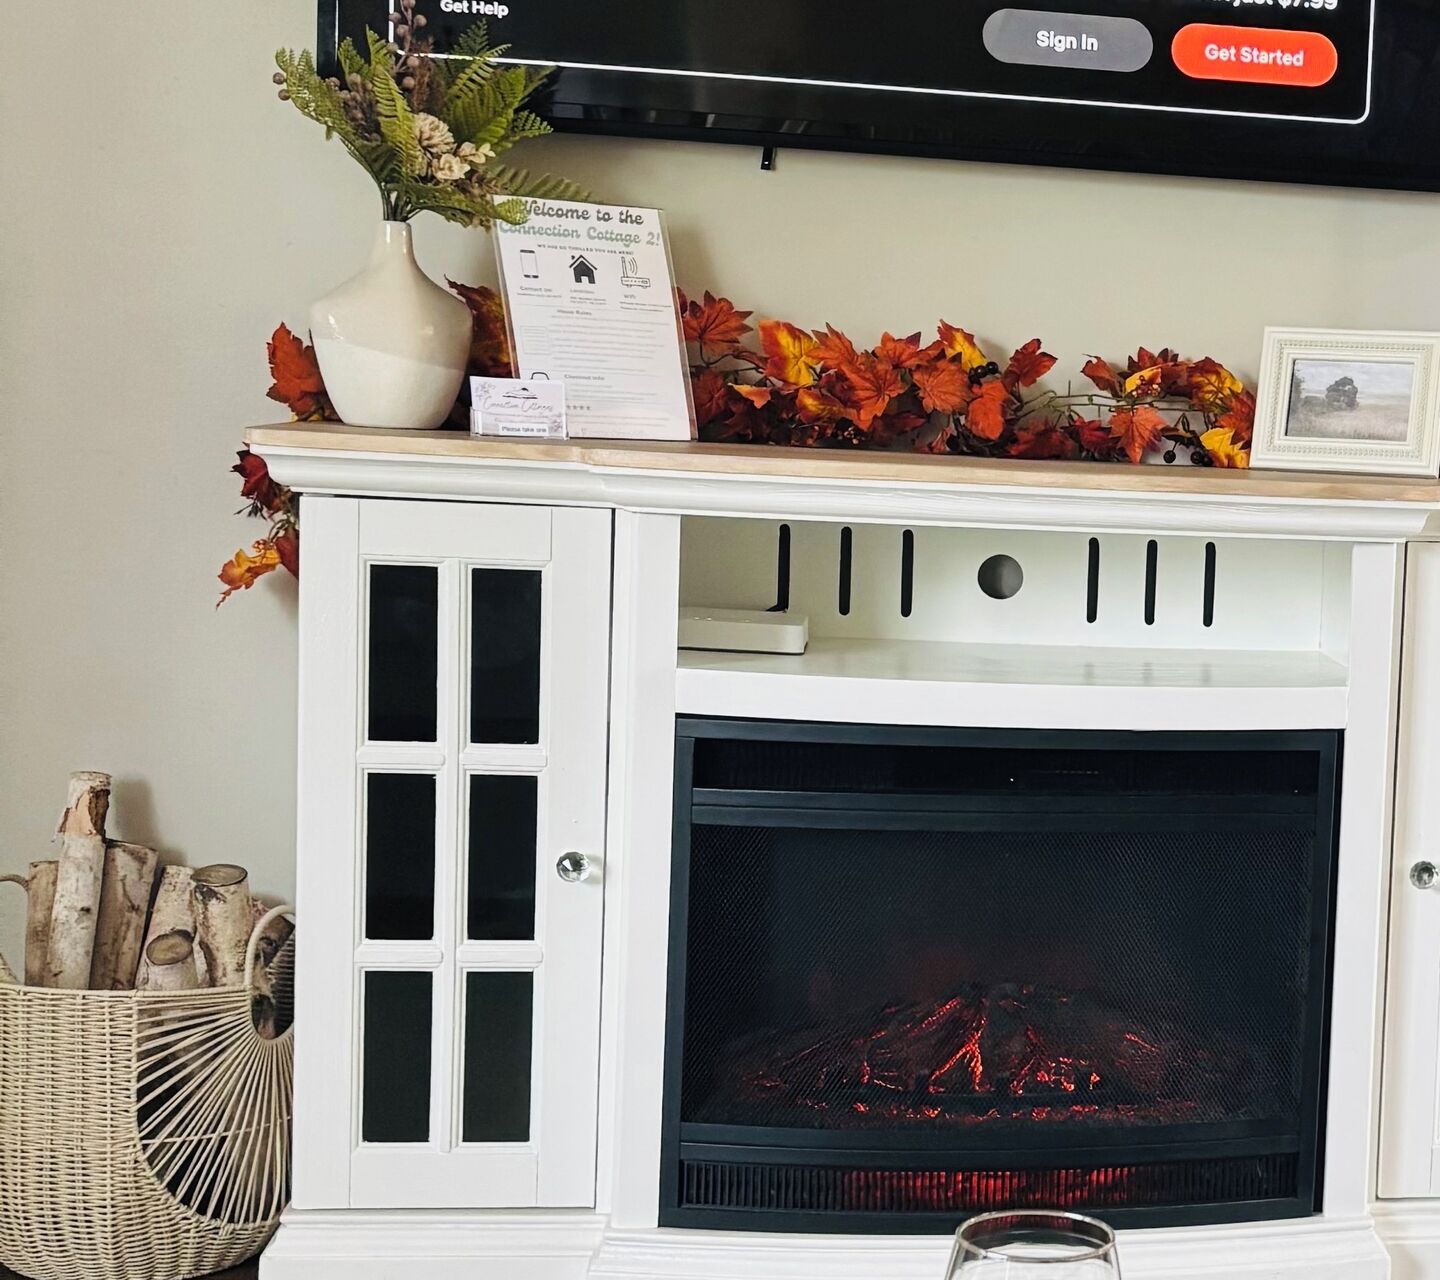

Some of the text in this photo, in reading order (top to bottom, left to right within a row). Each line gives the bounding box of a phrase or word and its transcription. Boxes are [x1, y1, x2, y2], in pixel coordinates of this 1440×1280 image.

[471, 0, 509, 19] Help
[1036, 30, 1098, 55] Sign In
[1205, 43, 1304, 68] Get Started
[596, 208, 613, 222] to
[619, 209, 644, 226] the
[499, 222, 661, 248] Connection Cottage 2!
